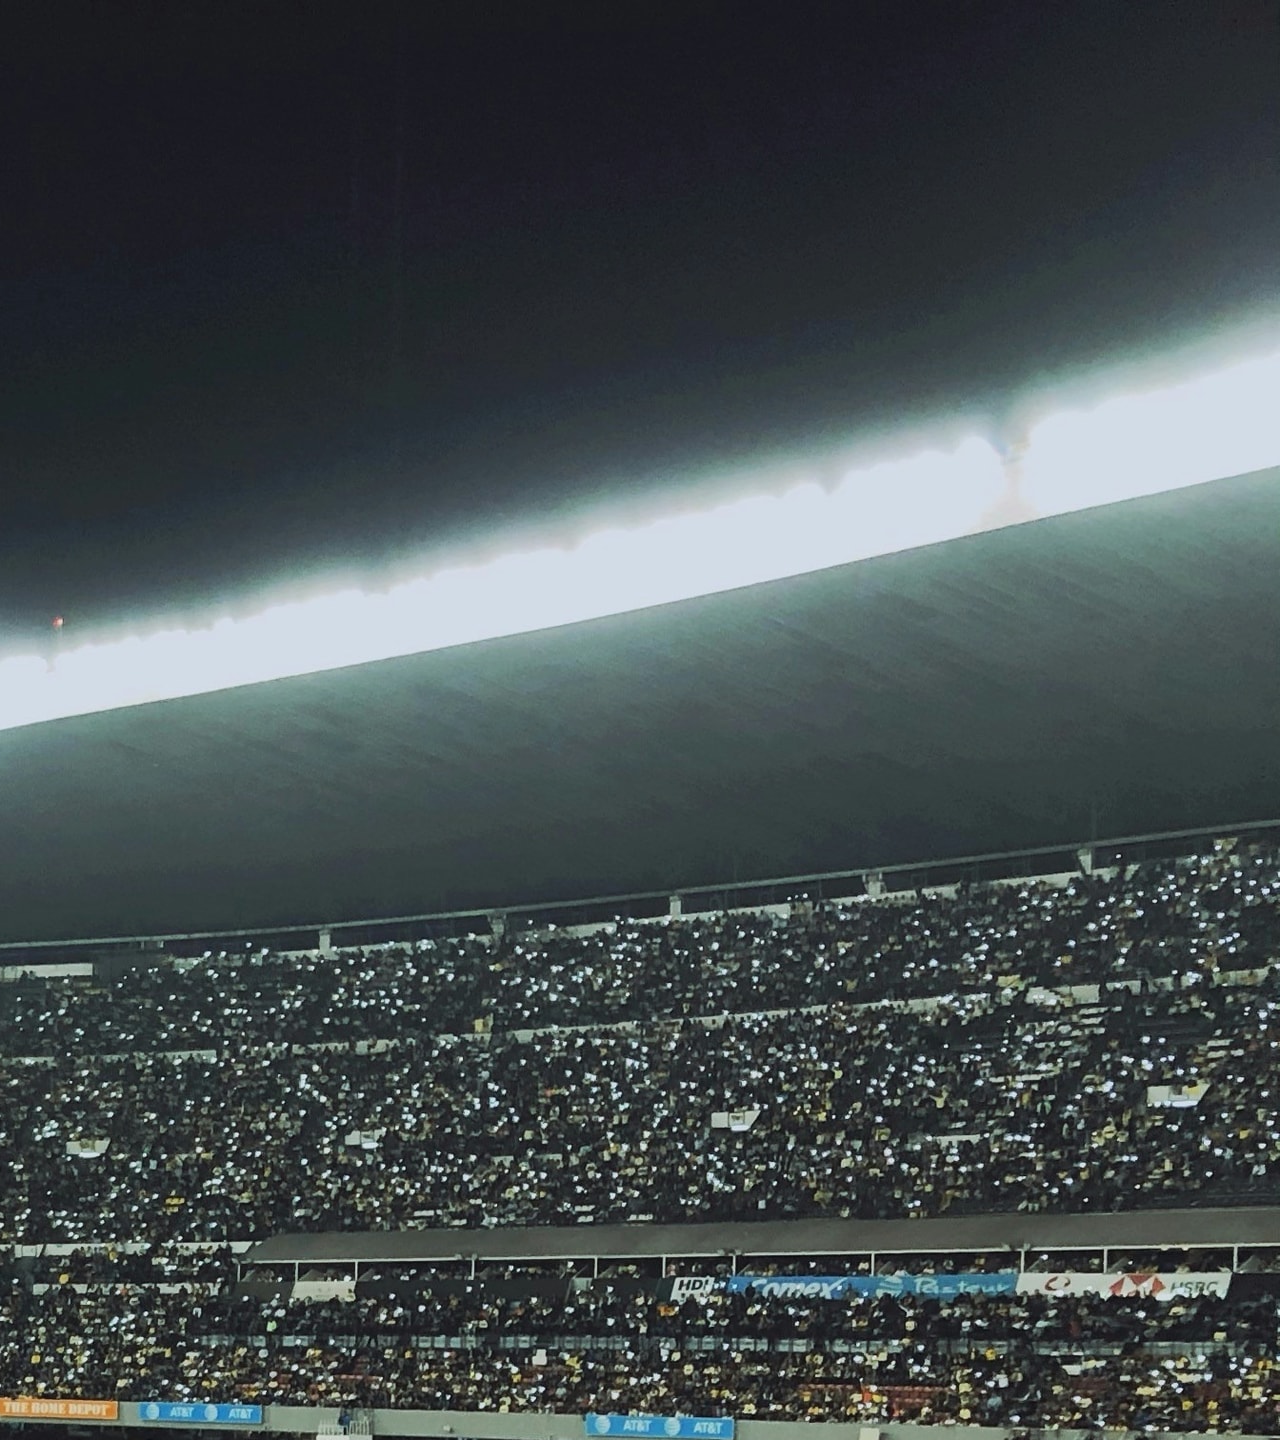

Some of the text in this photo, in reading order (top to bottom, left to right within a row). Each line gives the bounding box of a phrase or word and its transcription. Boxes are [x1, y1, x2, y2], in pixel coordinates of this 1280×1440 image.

[4, 1401, 109, 1416] THE HOME DEPOT
[169, 1407, 194, 1418] AT&T
[227, 1409, 253, 1420] AT&T
[623, 1419, 652, 1432] AT&T
[693, 1421, 723, 1435] AT&T
